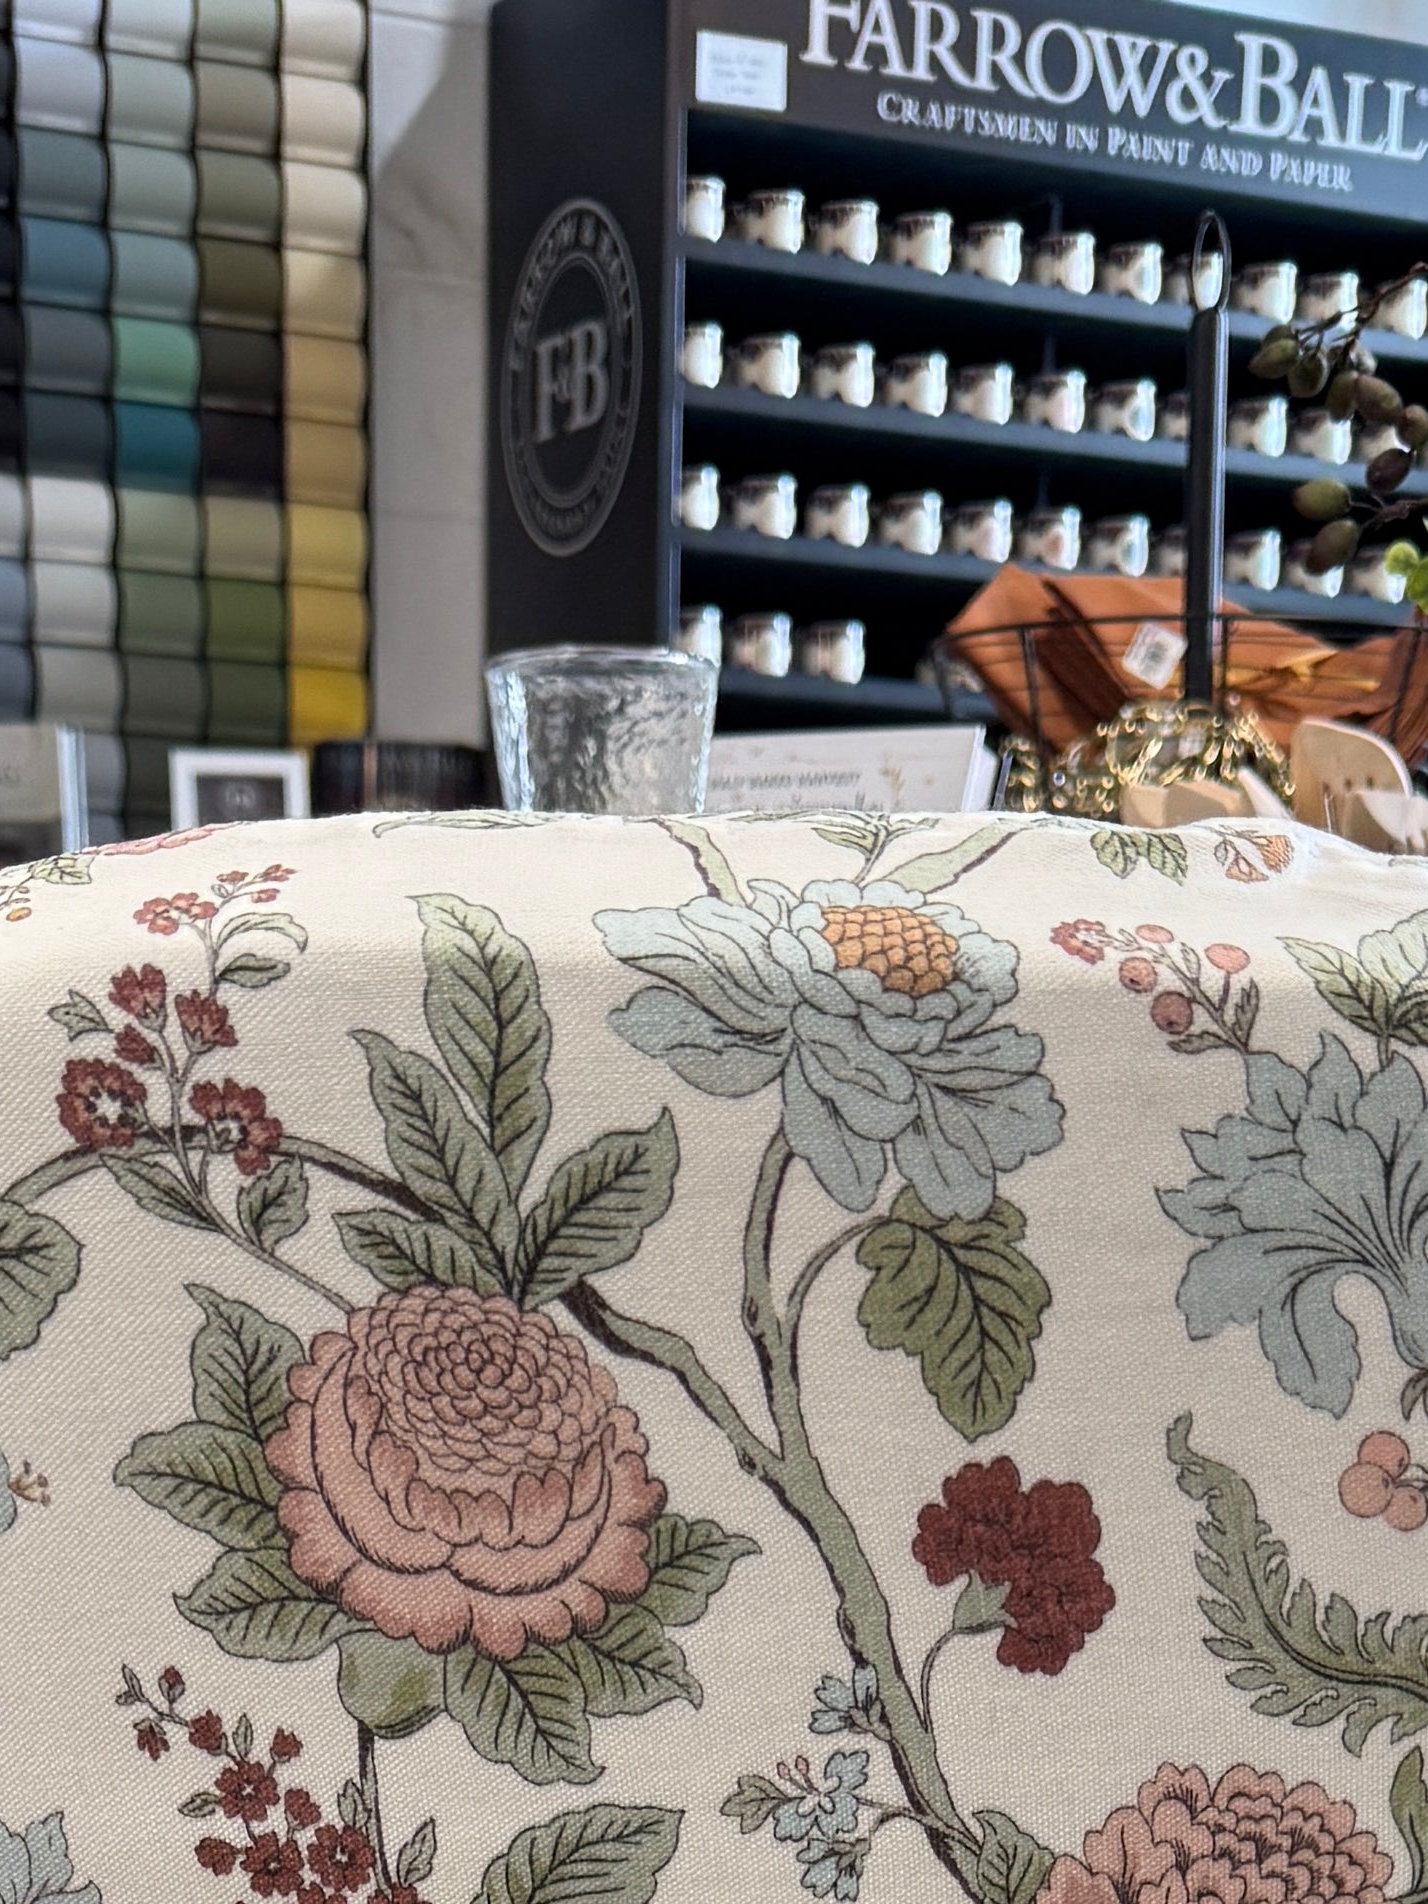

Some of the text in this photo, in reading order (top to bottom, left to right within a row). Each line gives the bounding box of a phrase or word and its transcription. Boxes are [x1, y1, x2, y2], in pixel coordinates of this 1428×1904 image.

[876, 88, 1354, 193] CRAFTSMEN IN PAINT AND PAPER
